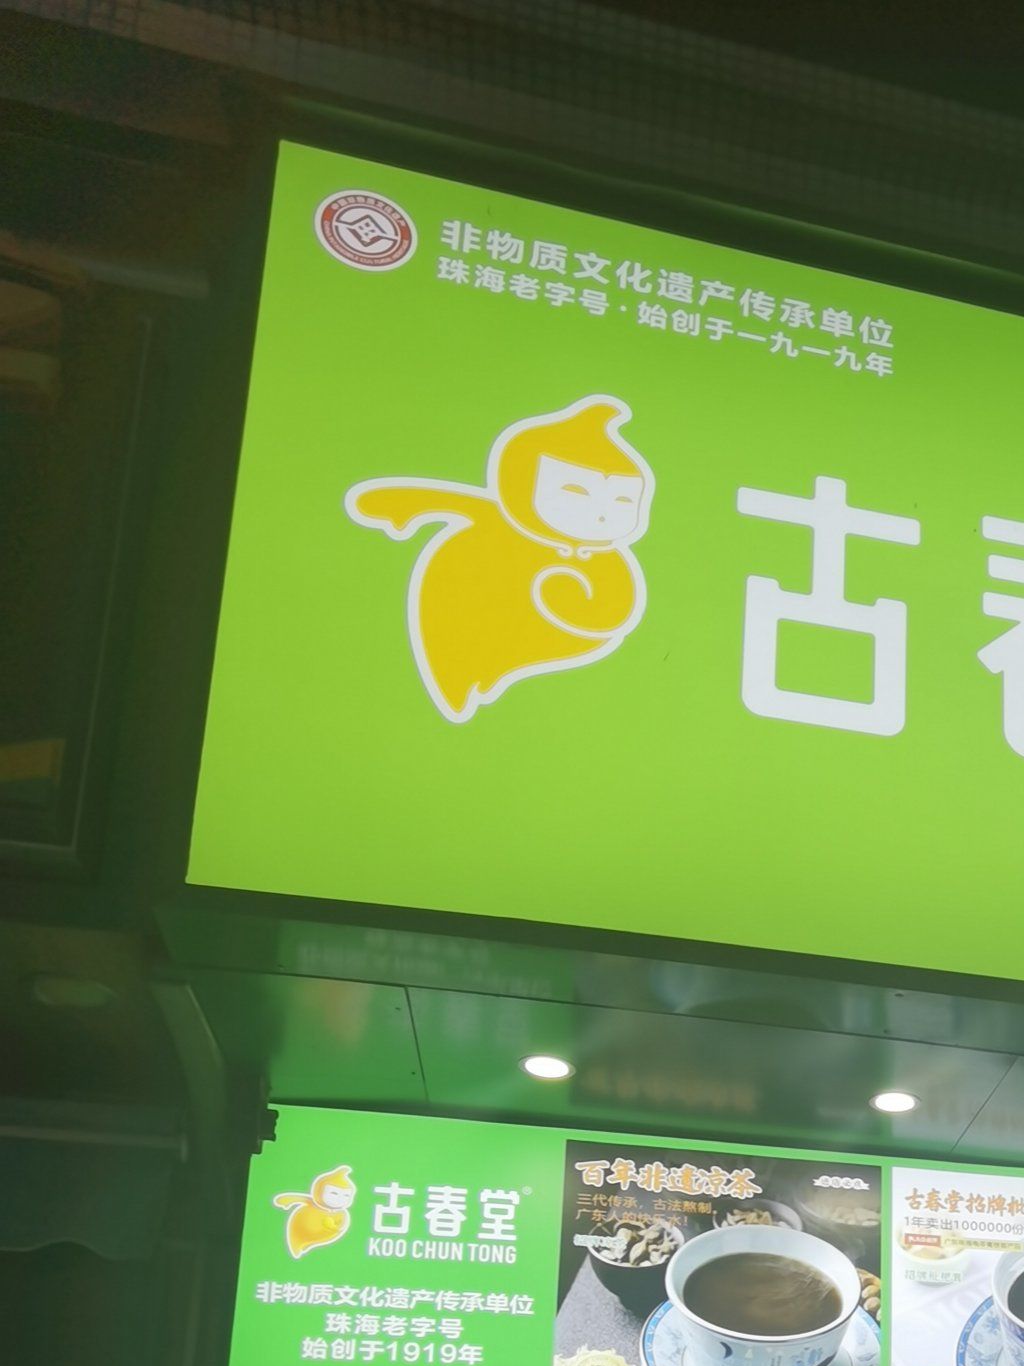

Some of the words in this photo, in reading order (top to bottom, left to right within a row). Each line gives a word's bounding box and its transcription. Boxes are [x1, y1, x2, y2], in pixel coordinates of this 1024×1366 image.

[440, 219, 895, 348] 非物质文化遗产传承单位
[575, 1158, 763, 1199] 百年非遗凉茶
[374, 1181, 519, 1241] 古春堂
[369, 1238, 407, 1260] KOO
[411, 1239, 465, 1262] CHUN
[468, 1241, 517, 1264] TONG
[256, 1282, 535, 1315] 非物质文化遗产传承单位
[325, 1312, 464, 1338] 珠海老字号
[302, 1337, 484, 1366] 始创于1919年
